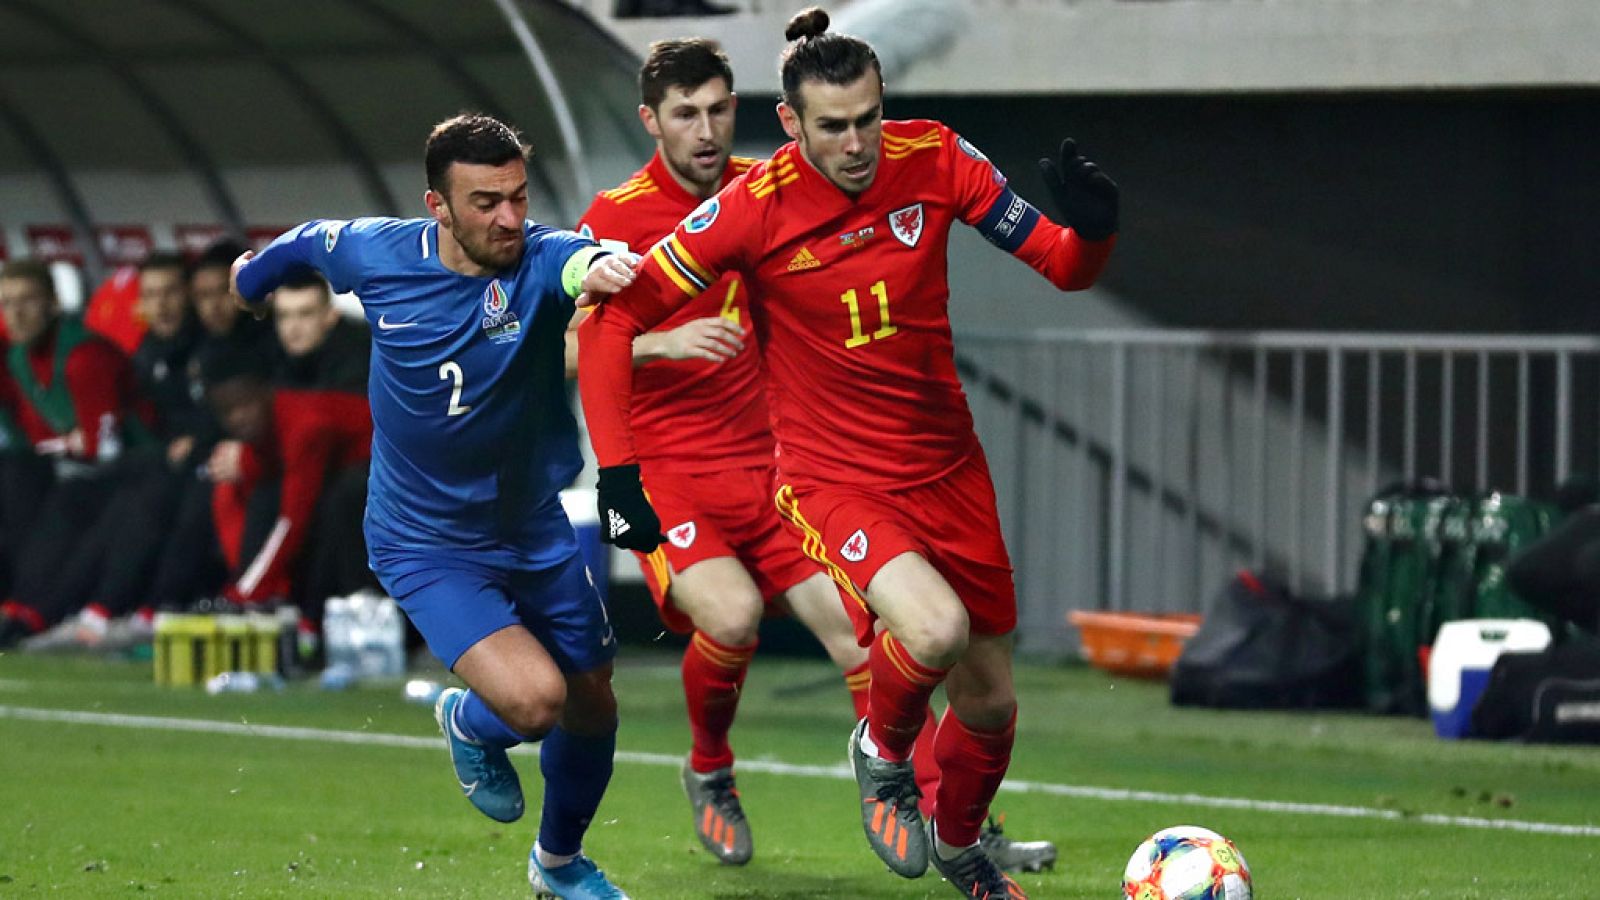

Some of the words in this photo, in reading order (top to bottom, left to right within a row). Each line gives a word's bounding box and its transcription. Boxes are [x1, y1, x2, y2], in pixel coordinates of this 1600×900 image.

[787, 259, 821, 271] adidas
[841, 280, 897, 349] 11
[439, 361, 472, 416] 2
[608, 508, 617, 539] adidas
